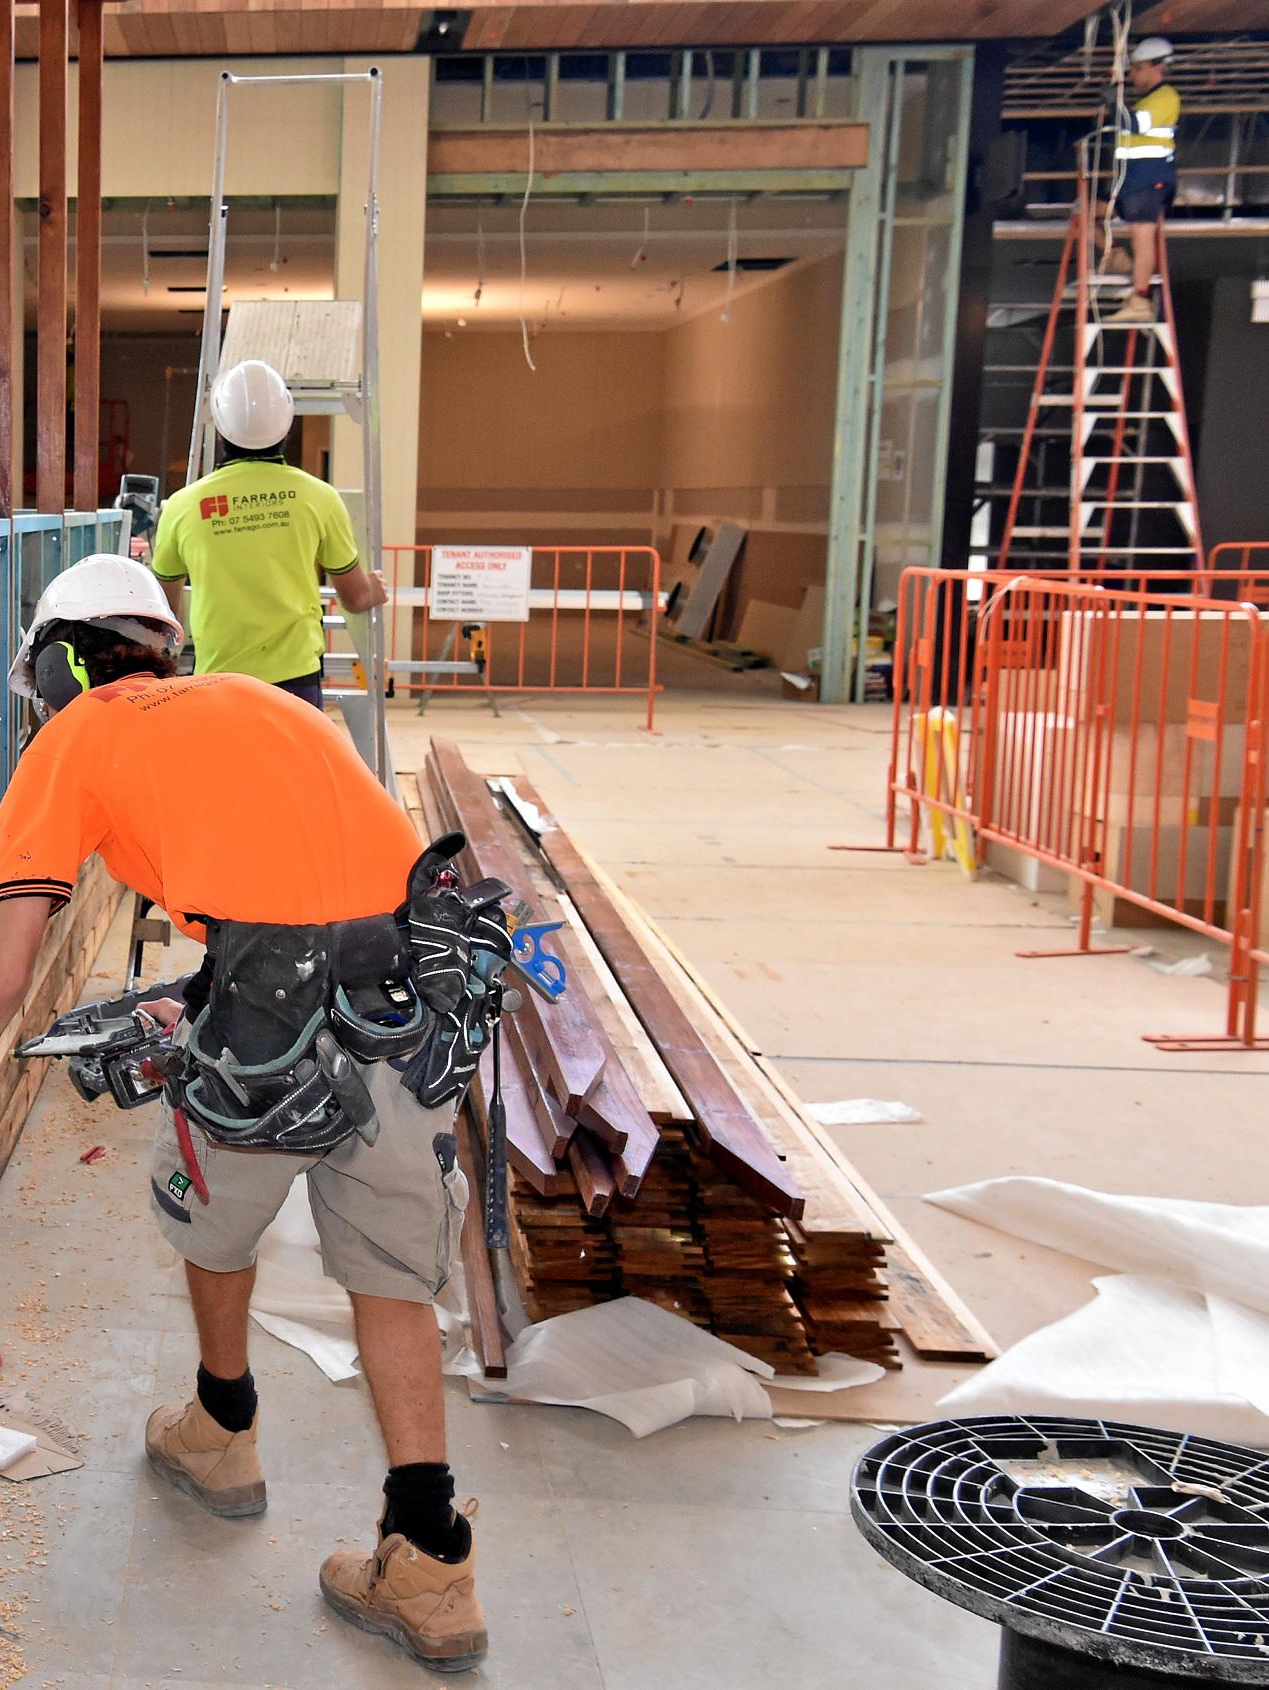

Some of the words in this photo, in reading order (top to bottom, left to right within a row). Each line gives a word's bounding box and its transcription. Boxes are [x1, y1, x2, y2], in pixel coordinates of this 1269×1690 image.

[232, 490, 296, 505] FARRAGO
[212, 519, 226, 527] Ph:
[229, 516, 240, 525] 07
[243, 513, 265, 523] 5493
[267, 510, 290, 520] 7608
[214, 521, 290, 535] www.farrago.com.au
[442, 551, 471, 559] TENANT
[474, 551, 523, 560] AUTHORISED
[456, 562, 485, 570] ACCESS
[488, 562, 507, 571] ONLY
